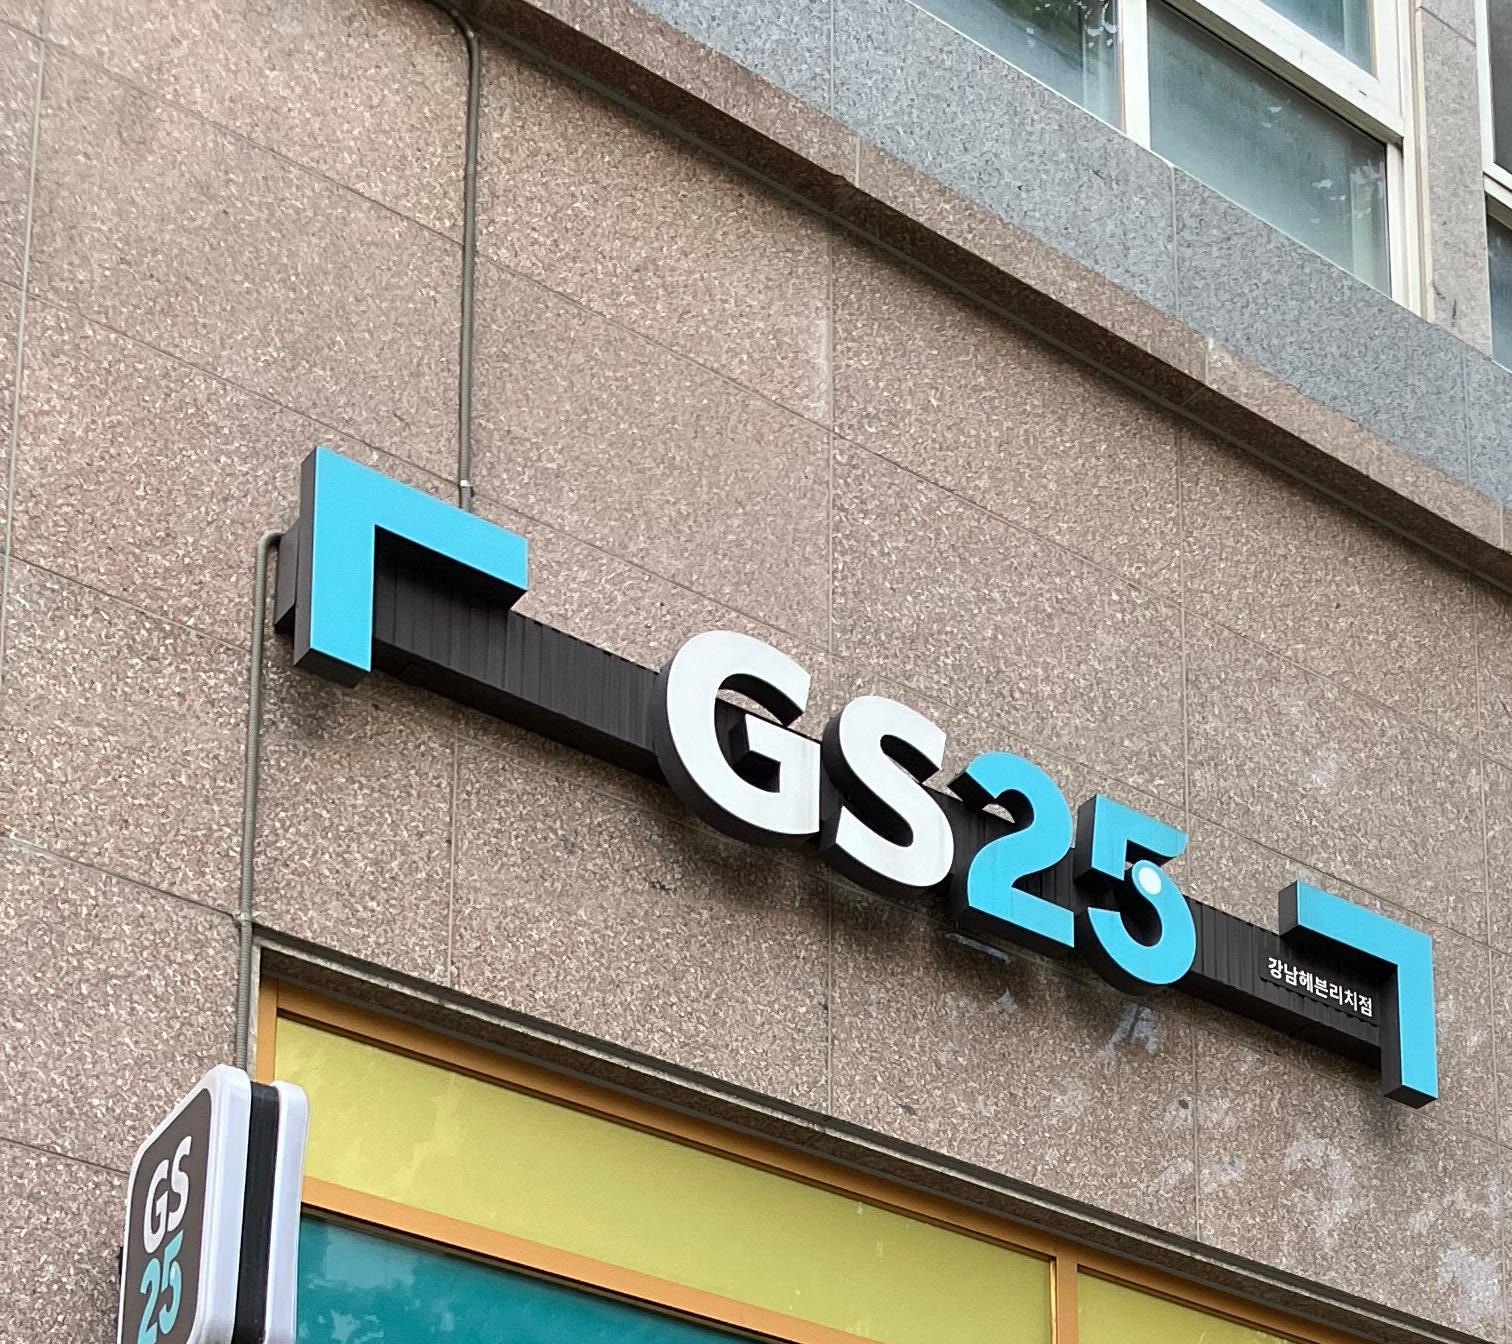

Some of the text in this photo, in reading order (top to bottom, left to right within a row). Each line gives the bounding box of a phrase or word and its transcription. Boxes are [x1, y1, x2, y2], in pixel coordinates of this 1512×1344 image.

[658, 628, 1197, 989] GS25
[1266, 955, 1374, 1019] 강남헤븐리치점
[143, 1135, 192, 1254] GS
